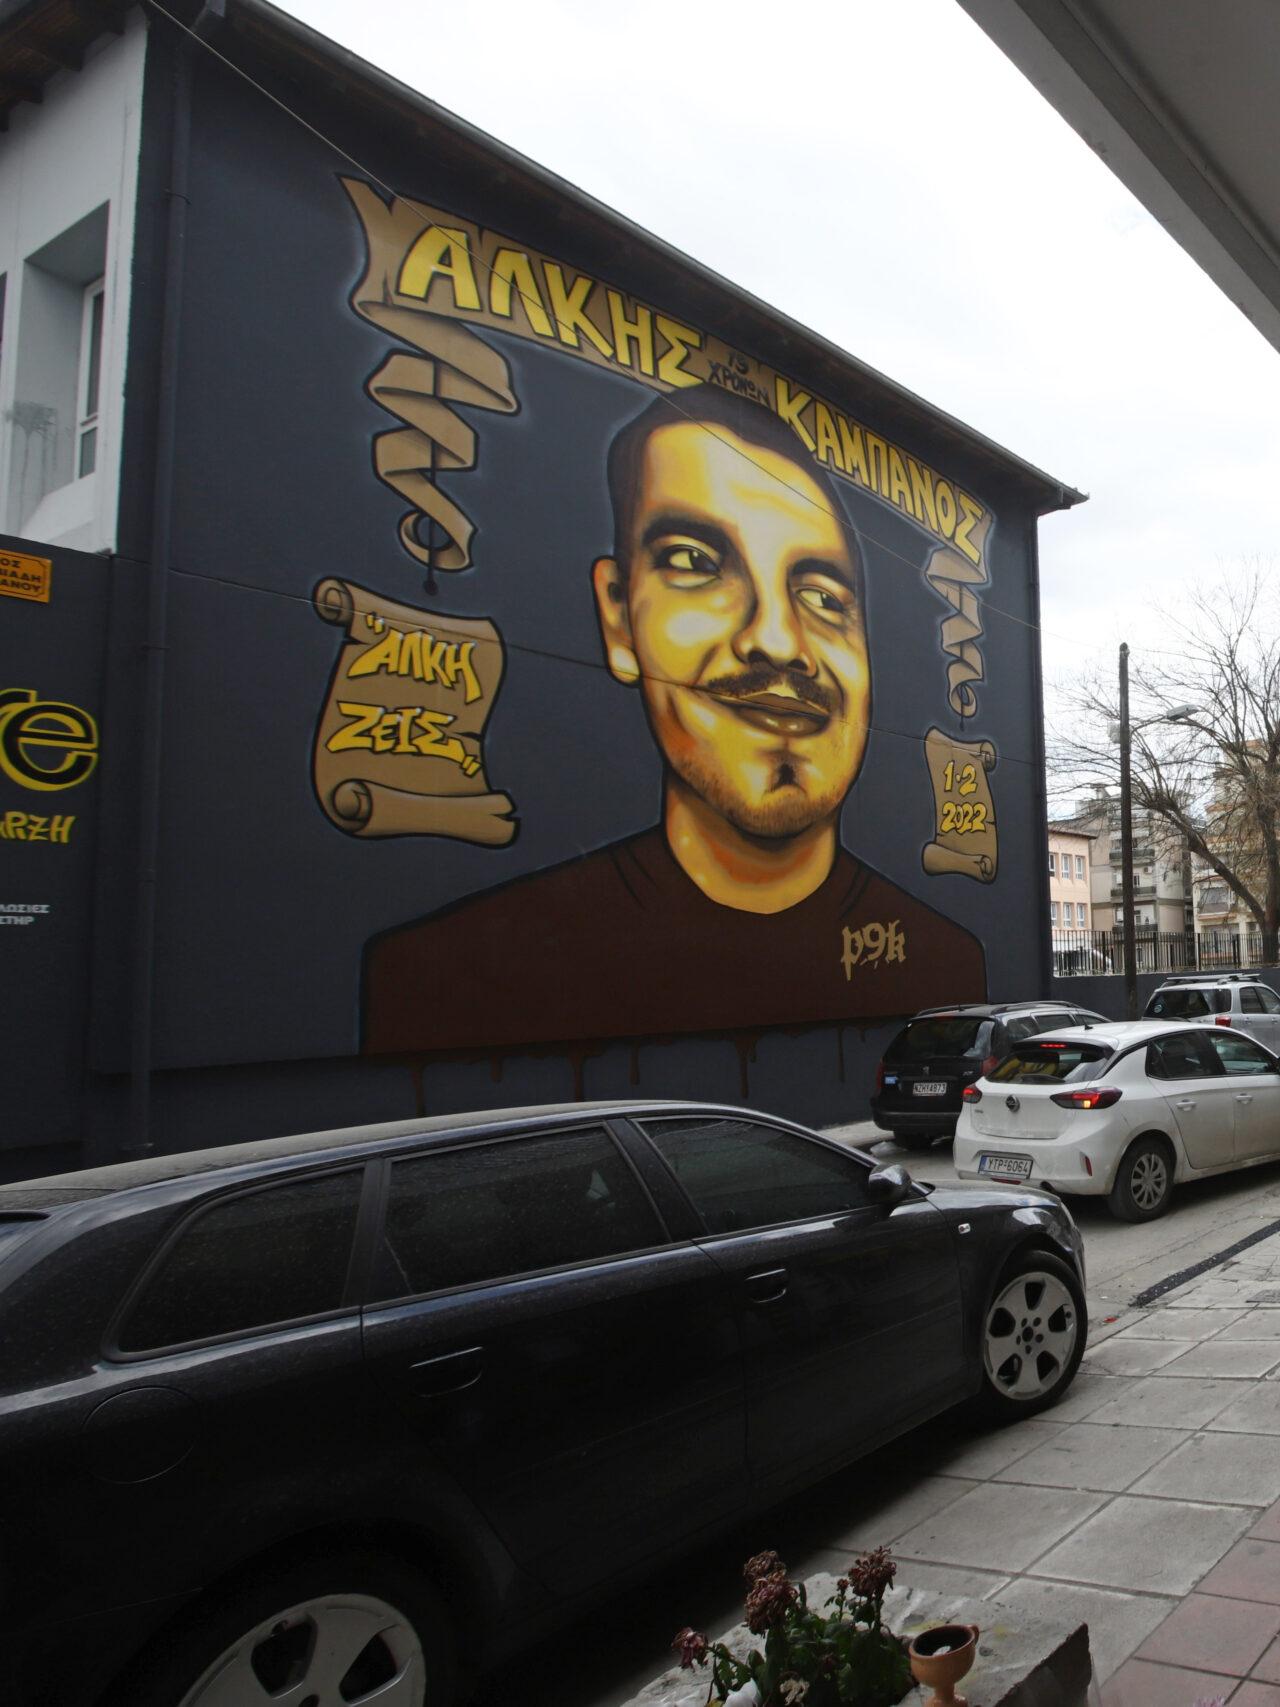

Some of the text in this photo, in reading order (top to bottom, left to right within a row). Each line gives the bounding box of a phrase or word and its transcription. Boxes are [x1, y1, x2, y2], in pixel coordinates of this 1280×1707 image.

[396, 223, 705, 389] ΑΛΚΗΣ
[773, 373, 988, 566] ΚΑΜΠΑΝΟΣ
[940, 801, 988, 835] 2022
